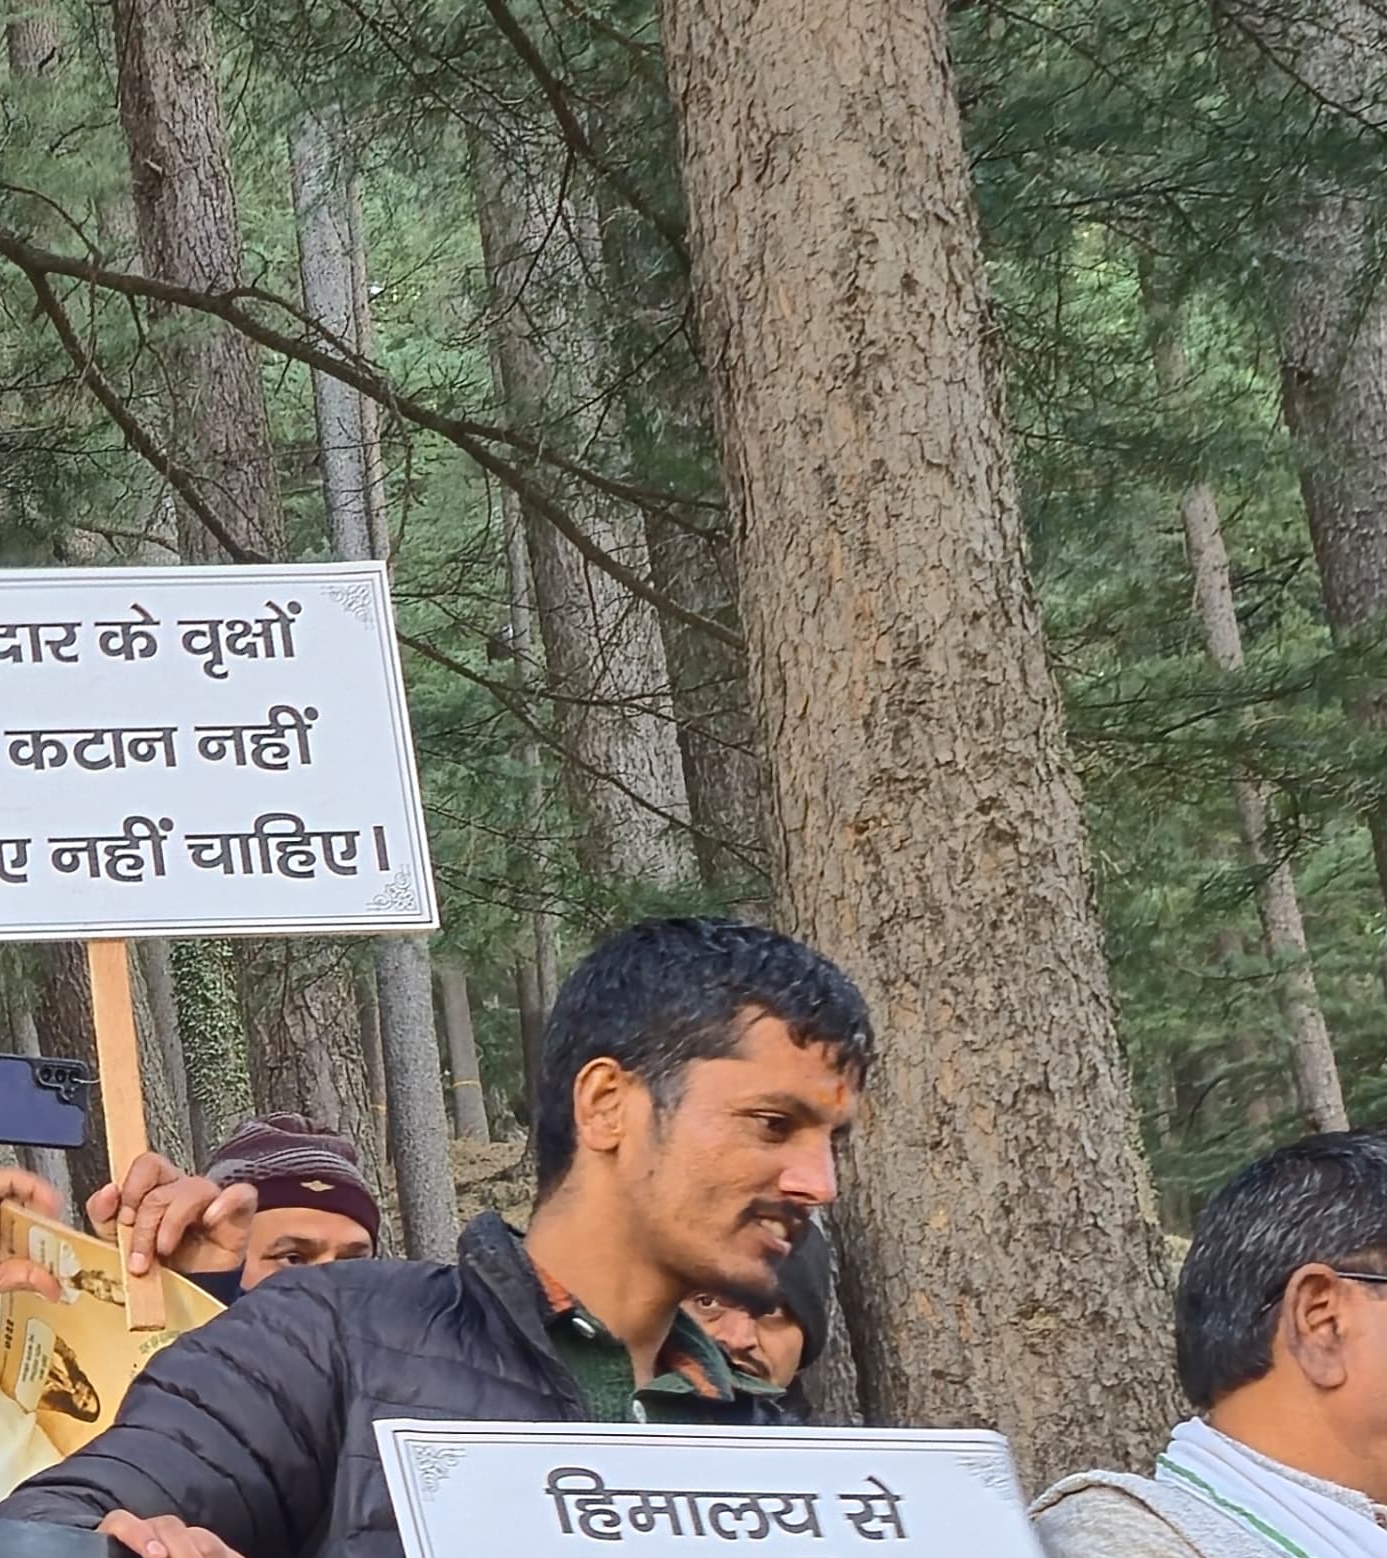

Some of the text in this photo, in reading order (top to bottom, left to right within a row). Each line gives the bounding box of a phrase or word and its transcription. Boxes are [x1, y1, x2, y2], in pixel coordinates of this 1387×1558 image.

[94, 604, 161, 661] के
[178, 601, 302, 679] वृक्षों
[4, 727, 178, 771] कटान
[194, 705, 319, 771] नहीं
[47, 816, 174, 883] नहीं
[545, 1467, 907, 1541] हिमालय से
